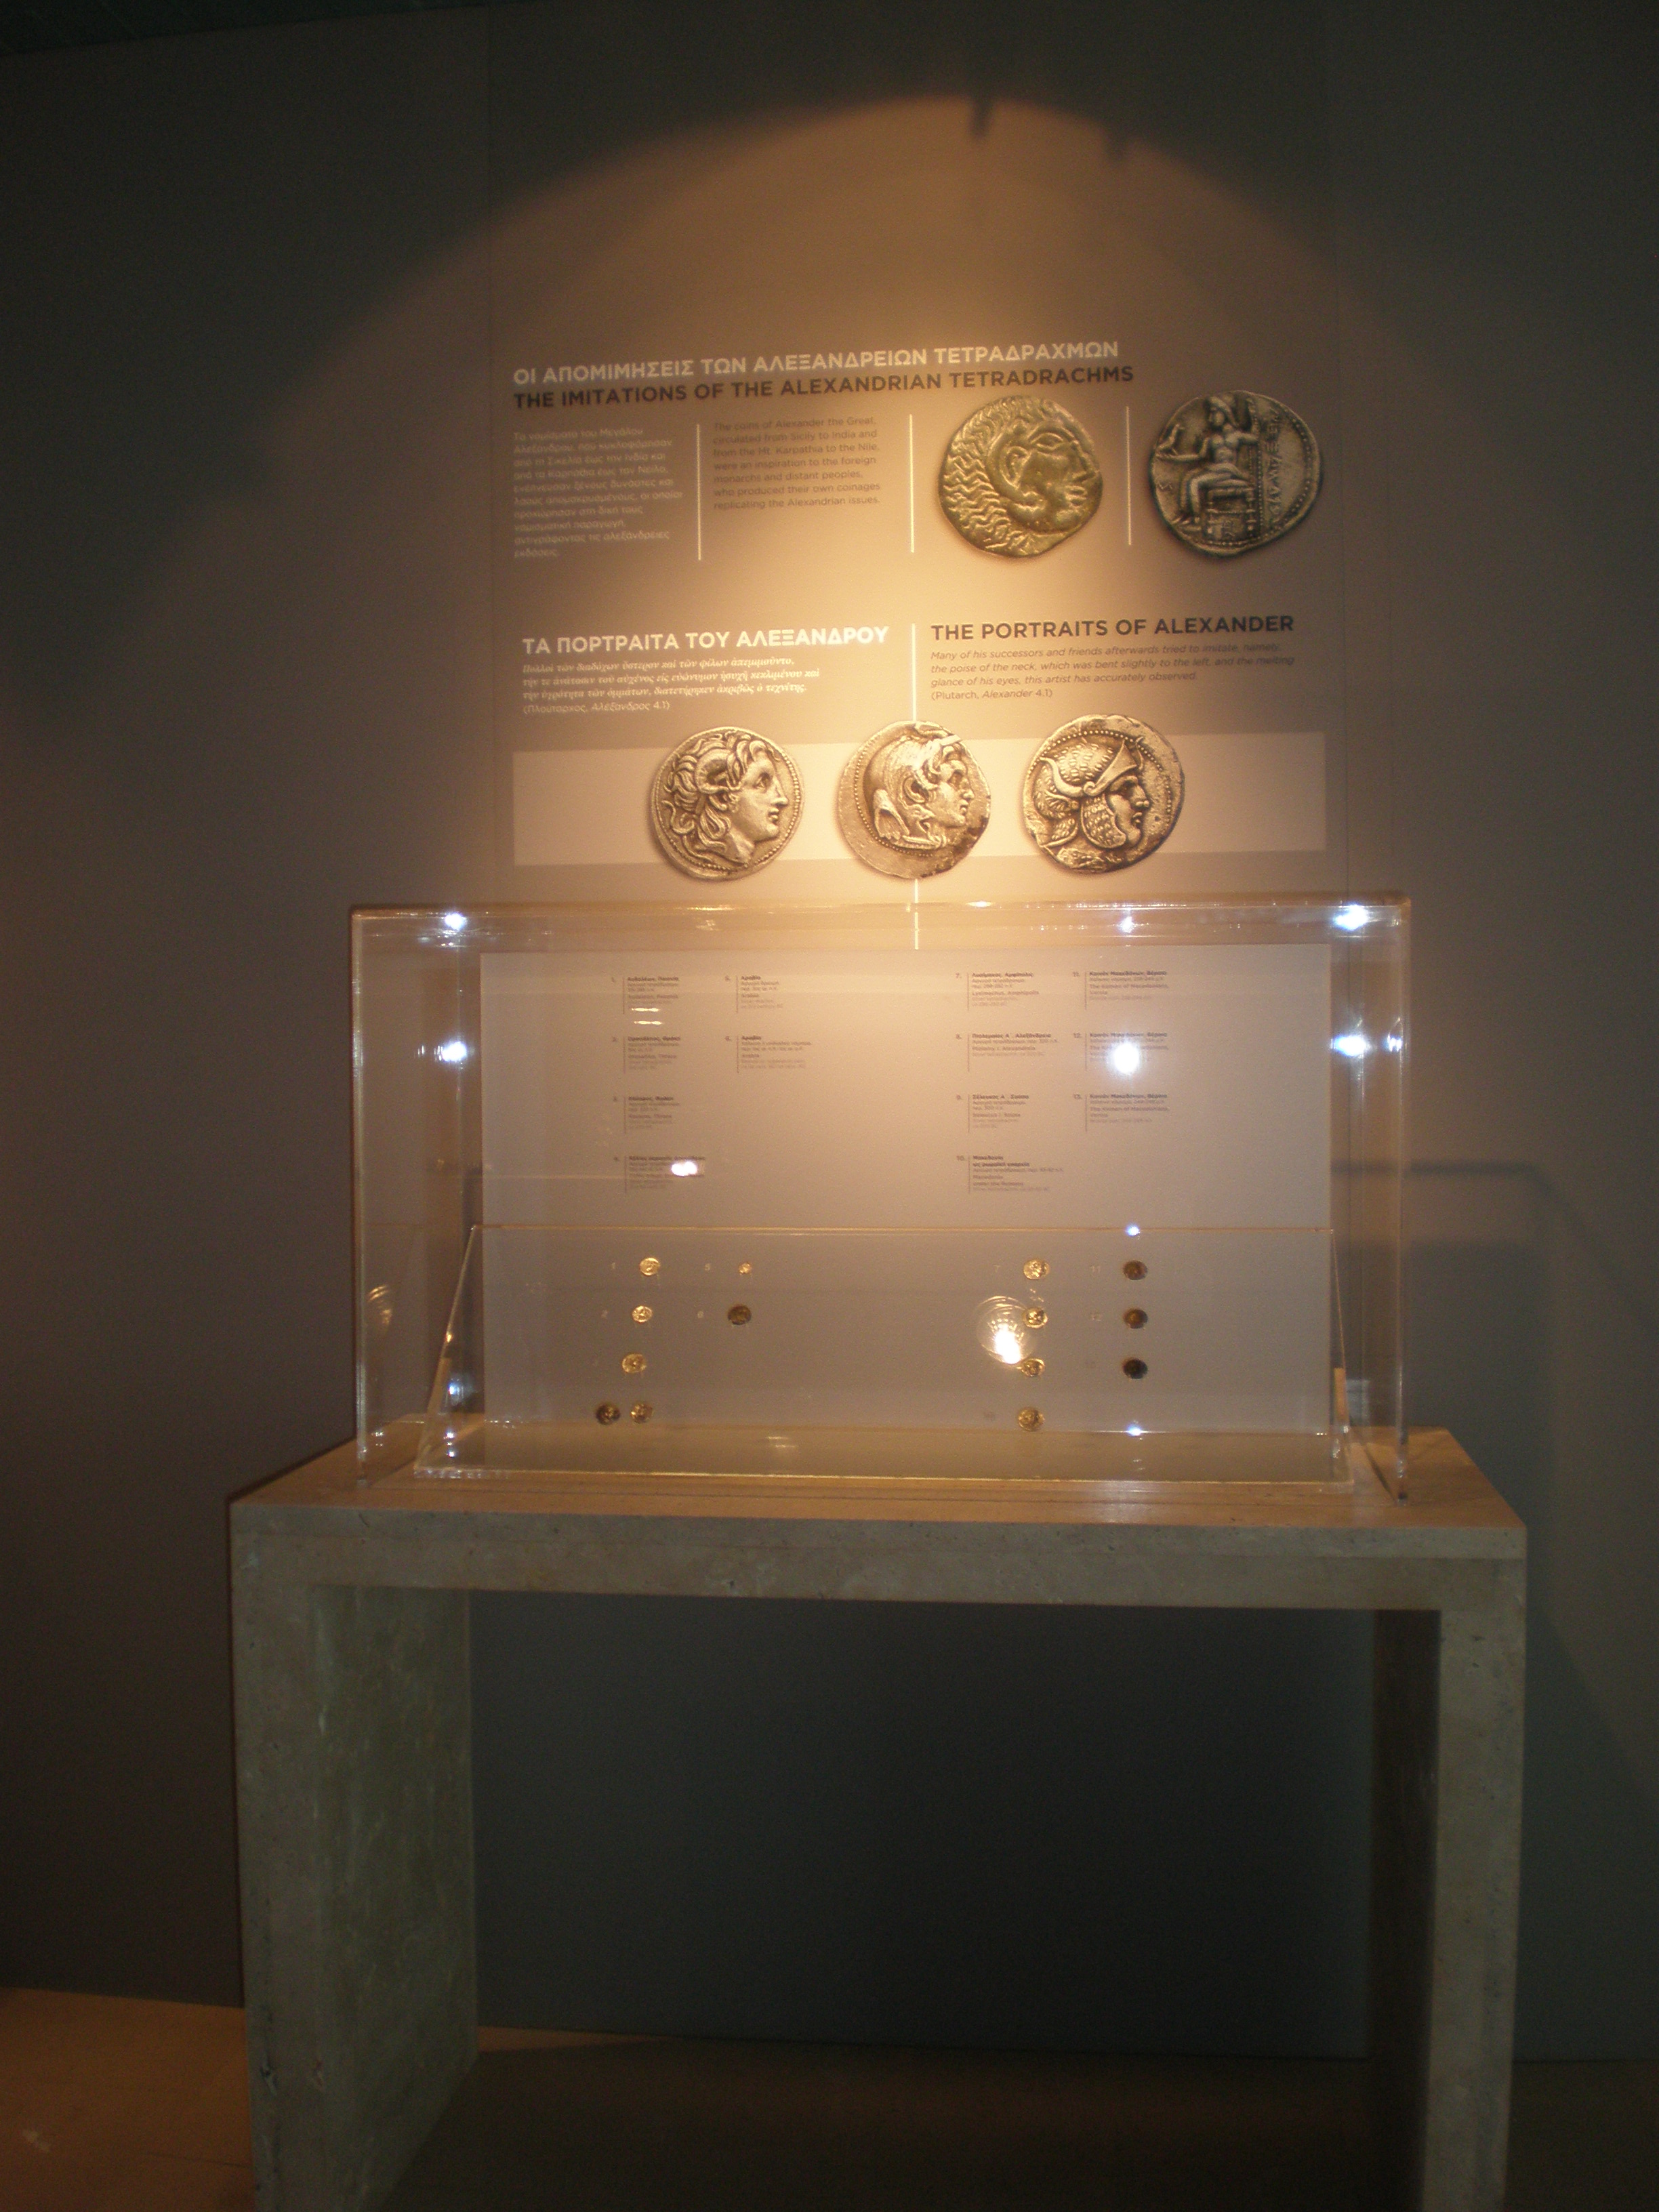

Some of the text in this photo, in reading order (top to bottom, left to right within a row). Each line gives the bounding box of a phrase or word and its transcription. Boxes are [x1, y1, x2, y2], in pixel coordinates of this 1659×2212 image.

[514, 341, 1119, 385] ΟΙ ΑΠΟΜΙΜΗΣΕΙΣ ΤΩΝ ΑΛΕΞΑΝΔΡΕΙΩΝ ΤΕΤΡΑΔΡΑΧΜΩΝ
[514, 366, 1134, 409] THE IMITATIONS OF THE ALEXANDRIAN TETRADRACHMS
[762, 421, 772, 429] of
[776, 419, 824, 428] Alexander
[828, 418, 843, 426] the
[764, 434, 787, 443] from
[790, 432, 815, 442] Sicily
[819, 432, 829, 440] to
[832, 431, 856, 440] India
[859, 430, 877, 438] and
[714, 449, 737, 457] from
[740, 447, 755, 456] the
[827, 445, 836, 453] to
[840, 444, 855, 452] the
[755, 459, 806, 470] inspiration
[809, 458, 819, 466] to
[823, 457, 838, 466] the
[842, 456, 876, 466] foreign
[714, 474, 761, 483] monarchs
[764, 472, 782, 481] and
[785, 472, 819, 480] distant
[714, 487, 735, 496] who
[738, 485, 784, 497] produced
[787, 485, 808, 493] their
[837, 483, 880, 493] coinages
[714, 499, 765, 510] replicating
[769, 498, 784, 507] the
[787, 497, 846, 506] Alexandrian
[931, 615, 1295, 640] THE PORTRAITS OF ALEXANDER
[522, 626, 890, 655] ΤΑ ΠΟΡΤΡΑΙΤΑ ΤΟΥ ΑΛΕΞΑΝΔΡΟΥ
[930, 652, 957, 661] Many
[960, 651, 970, 659] of
[973, 651, 987, 659] his
[990, 651, 1043, 659] successors
[1046, 649, 1065, 657] and
[1069, 648, 1102, 657] friends
[1105, 647, 1159, 655] afterwards
[1163, 646, 1185, 654] tried
[1189, 645, 1199, 653] to
[931, 665, 947, 673] the
[950, 664, 976, 675] poise
[979, 664, 989, 672] of
[993, 663, 1008, 672] the
[1041, 662, 1069, 670] which
[1095, 661, 1118, 670] bent
[1121, 660, 1155, 670] slightly
[1160, 659, 1170, 668] to
[1174, 659, 1189, 668] the
[1215, 658, 1233, 666] and
[1237, 657, 1253, 665] the
[1256, 657, 1294, 666] melting
[931, 678, 963, 689] glance
[967, 677, 977, 686] of
[981, 677, 994, 685] his
[1025, 676, 1042, 684] this
[1046, 675, 1070, 684] artist
[1073, 675, 1090, 683] has
[1094, 674, 1145, 684] accurately
[983, 690, 1032, 698] Alexander
[1036, 689, 1052, 699] 4.1)
